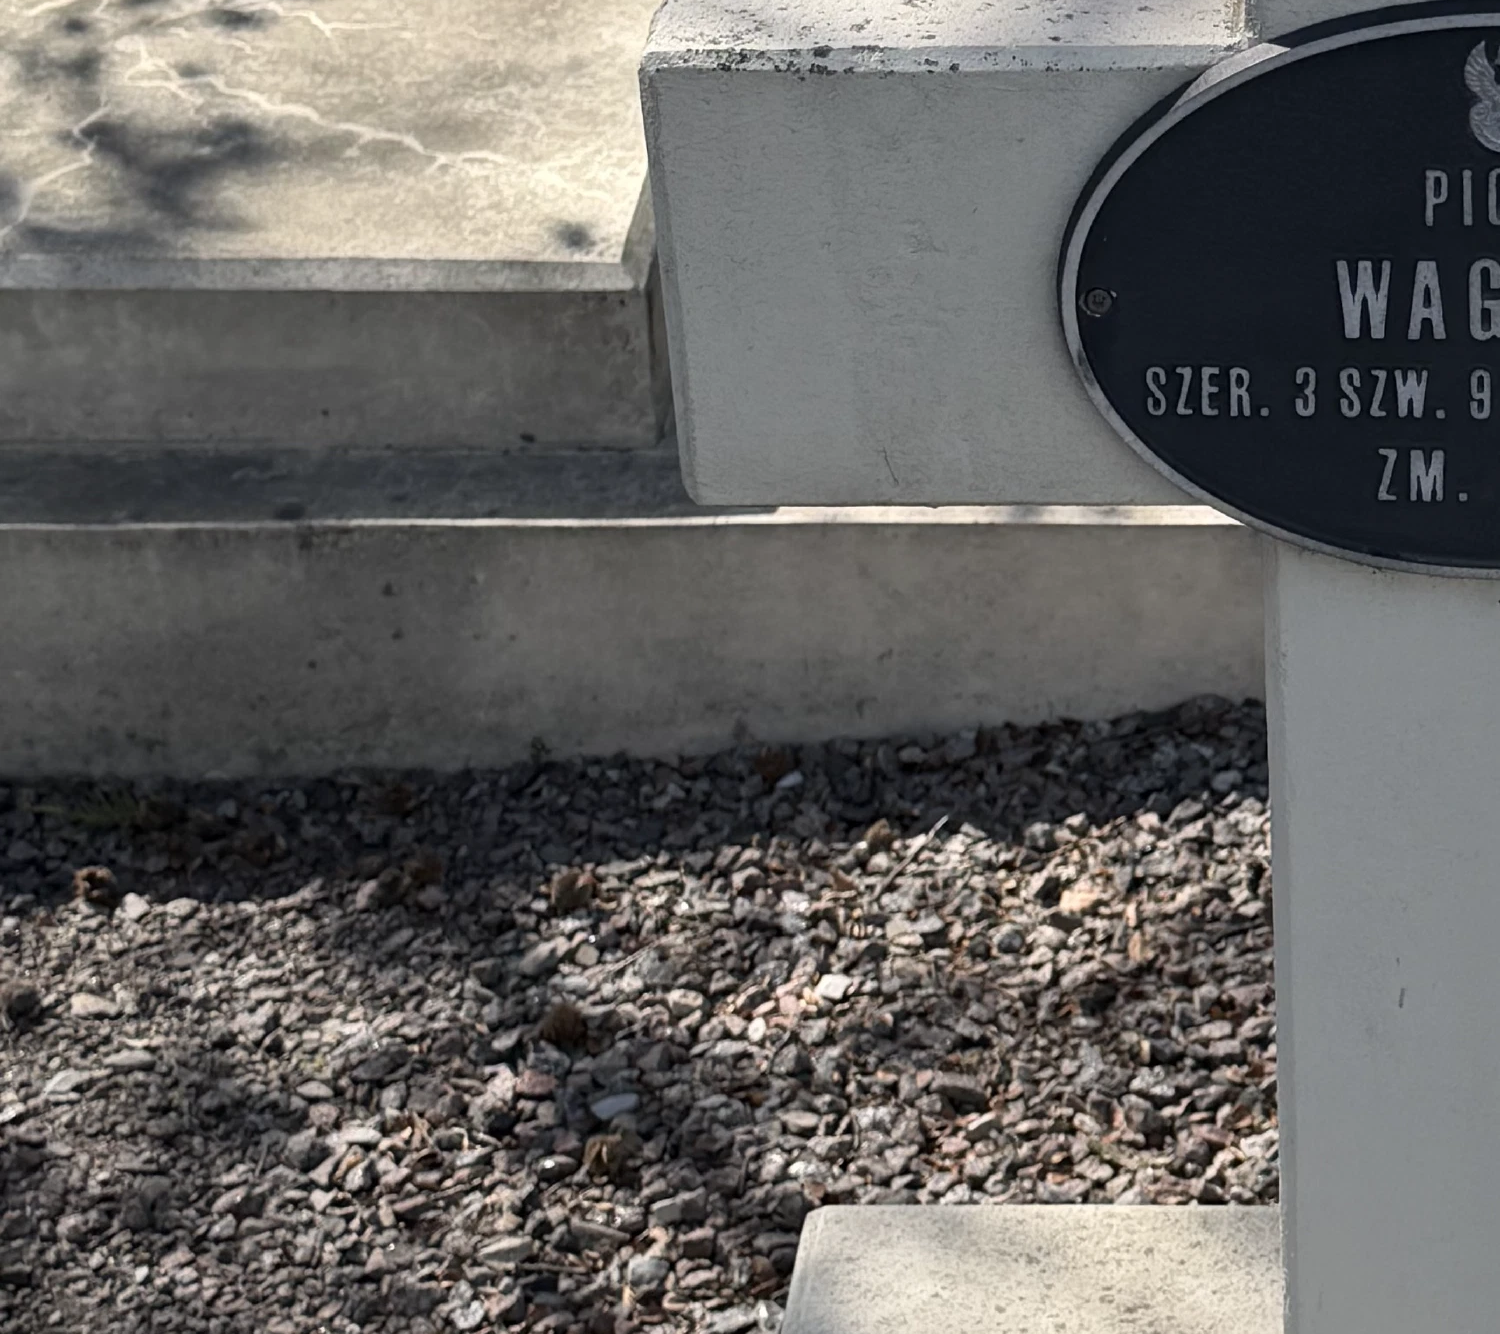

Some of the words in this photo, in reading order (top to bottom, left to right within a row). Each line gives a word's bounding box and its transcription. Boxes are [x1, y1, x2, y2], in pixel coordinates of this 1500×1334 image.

[1145, 365, 1271, 418] SZER.
[1294, 366, 1317, 418] 3
[1338, 366, 1448, 420] SZW.
[1469, 368, 1492, 421] 9
[1377, 447, 1470, 503] ZM.
